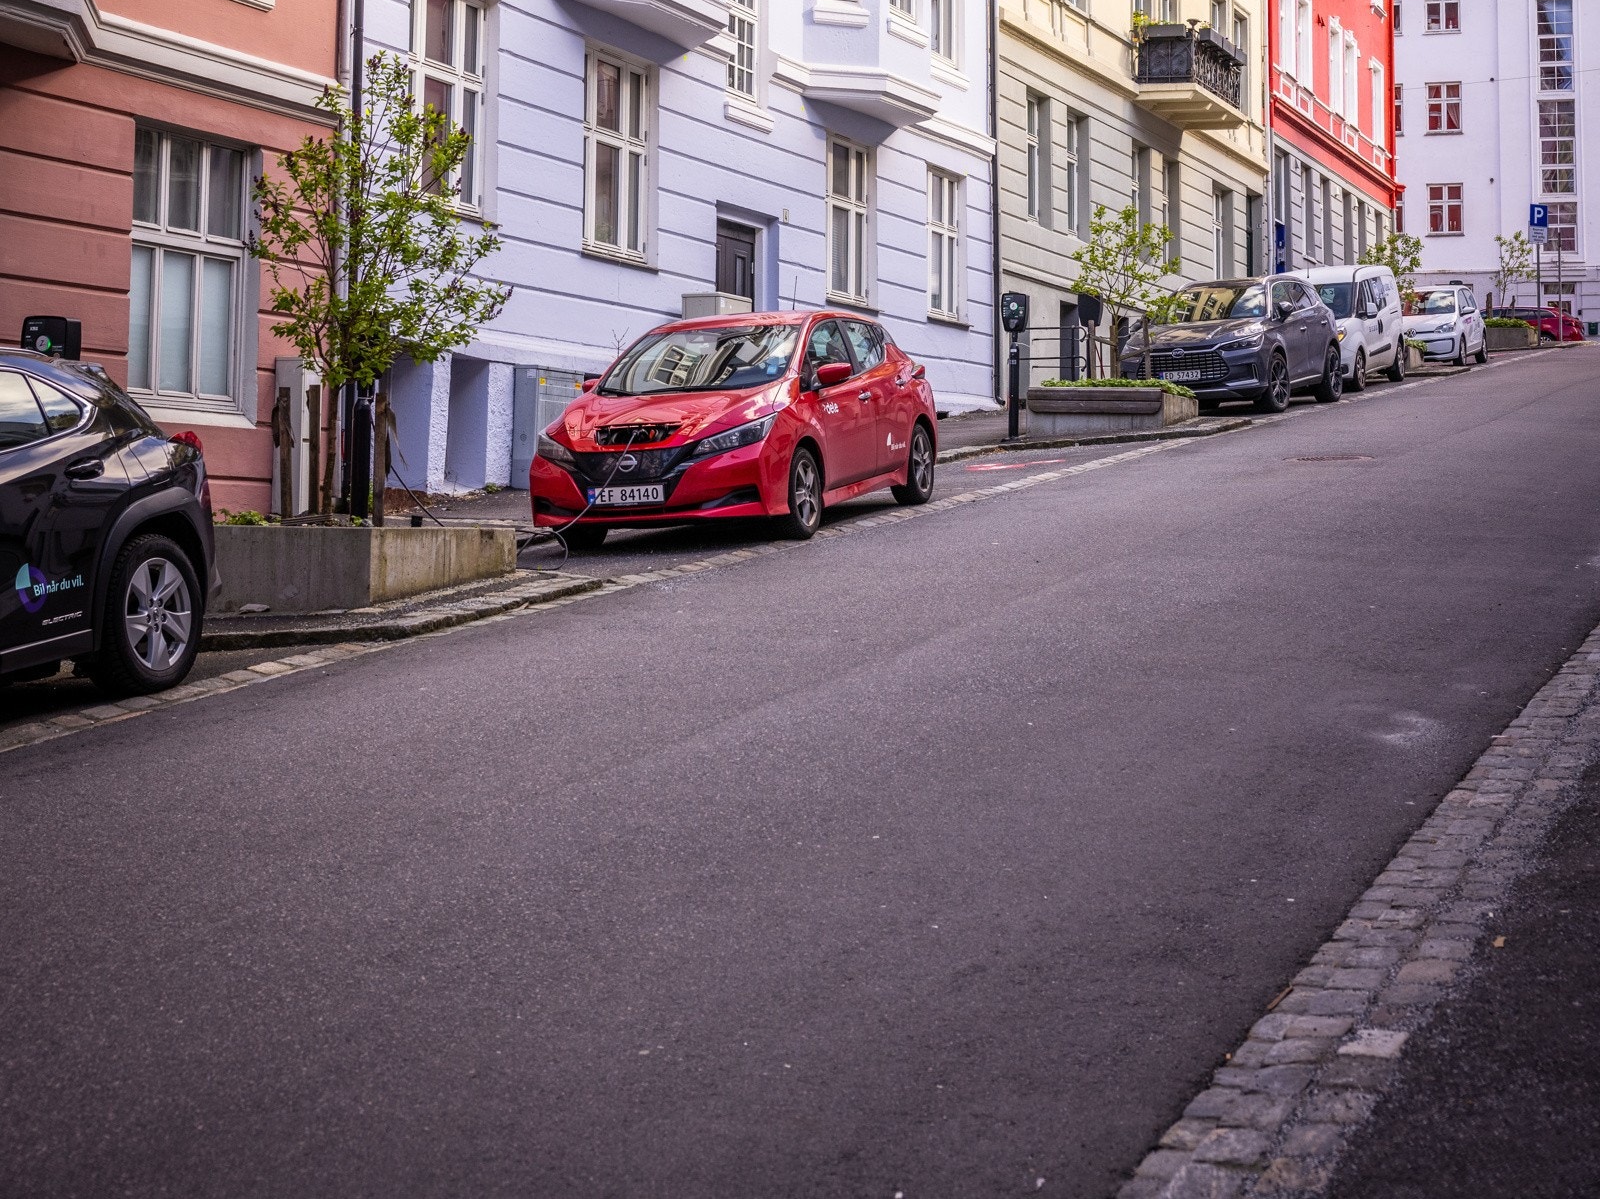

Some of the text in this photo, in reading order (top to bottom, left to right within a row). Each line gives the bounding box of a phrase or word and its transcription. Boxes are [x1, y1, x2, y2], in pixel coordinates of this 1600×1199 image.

[1534, 207, 1544, 224] P
[1164, 370, 1199, 380] ED 57432
[600, 487, 659, 503] EF 84140
[33, 574, 84, 597] Bil når du vil.
[42, 610, 83, 626] ELECTRIC
